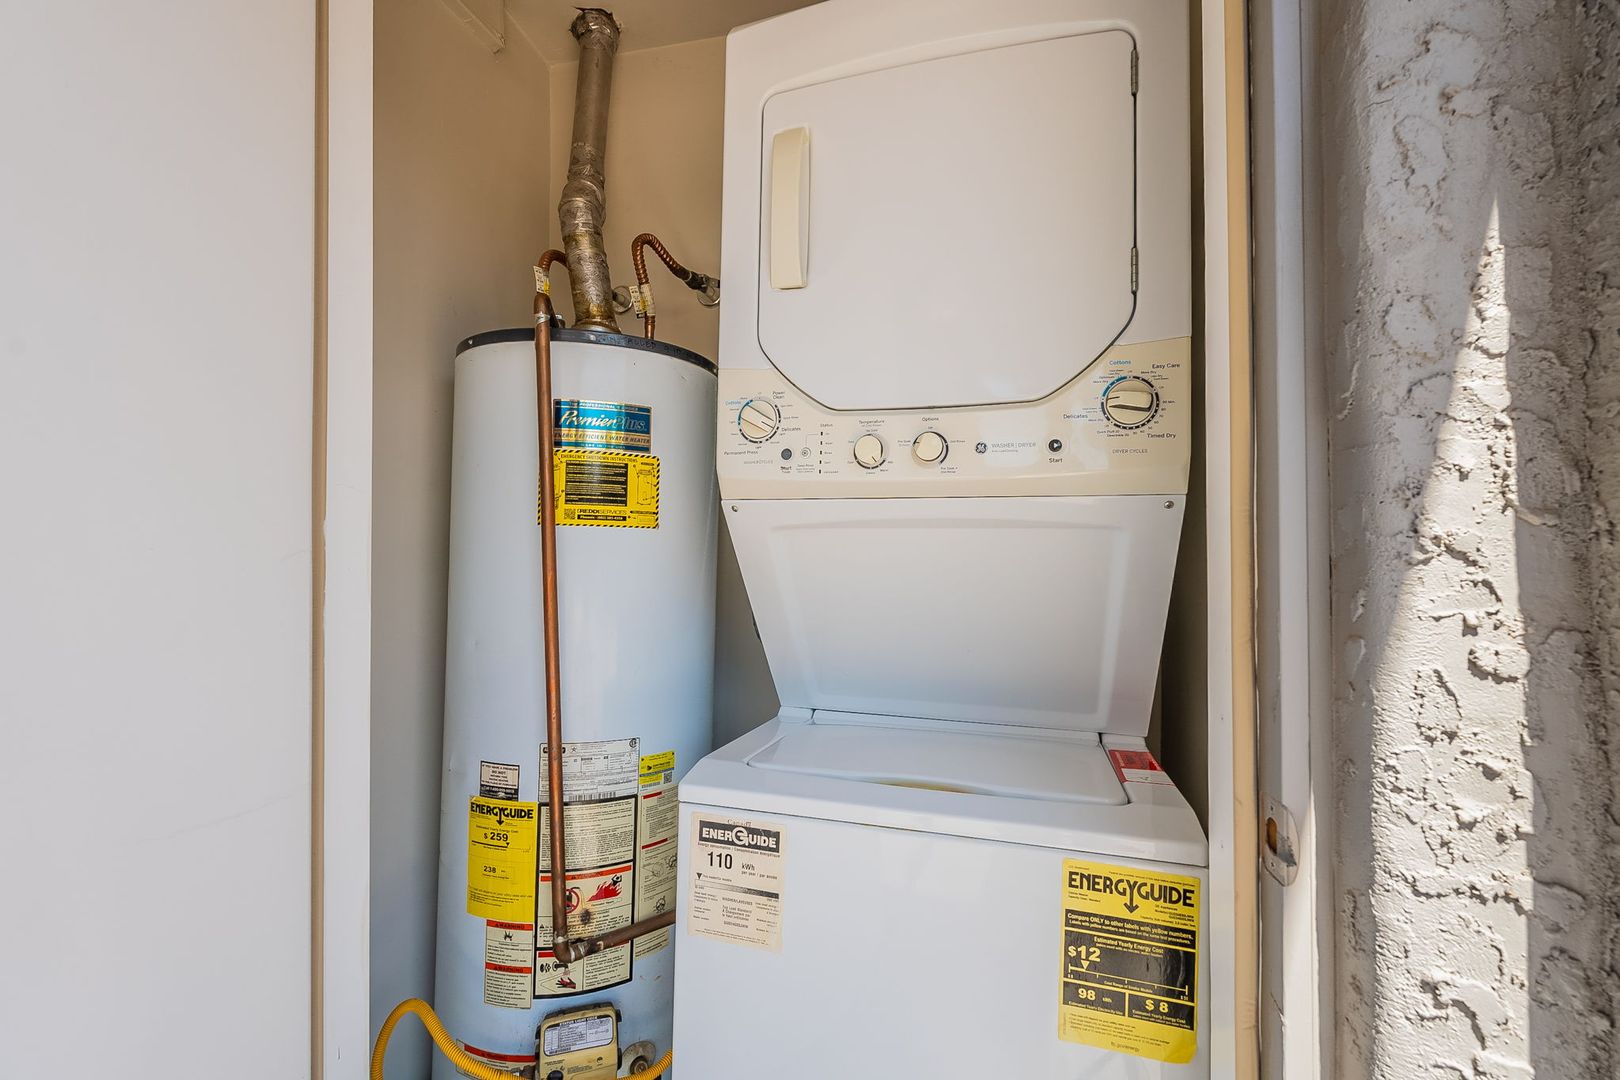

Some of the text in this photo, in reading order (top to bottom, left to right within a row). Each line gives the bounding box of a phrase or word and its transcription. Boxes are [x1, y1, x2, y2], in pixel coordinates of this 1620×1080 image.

[560, 410, 616, 428] Premier
[609, 434, 628, 442] WATER
[630, 437, 650, 445] HEATER
[470, 802, 534, 820] ENERGYGUIDE
[490, 832, 508, 842] 259
[702, 827, 777, 848] ENERGUIDE
[708, 852, 733, 870] 110
[742, 863, 756, 871] kWh
[483, 865, 497, 874] 238
[1068, 871, 1196, 908] ENERGYGUIDE
[1067, 913, 1089, 923] Compare
[1151, 927, 1169, 936] yellow
[1169, 930, 1194, 940] numbers.
[1094, 936, 1118, 946] Estimated
[1118, 940, 1133, 949] Yearly
[1134, 944, 1151, 952] Energy
[1067, 944, 1101, 962] $12
[1078, 988, 1096, 1001] 98
[1068, 1000, 1087, 1008] Estimated
[1098, 1006, 1116, 1014] Electricity
[1145, 999, 1169, 1013] $ 8
